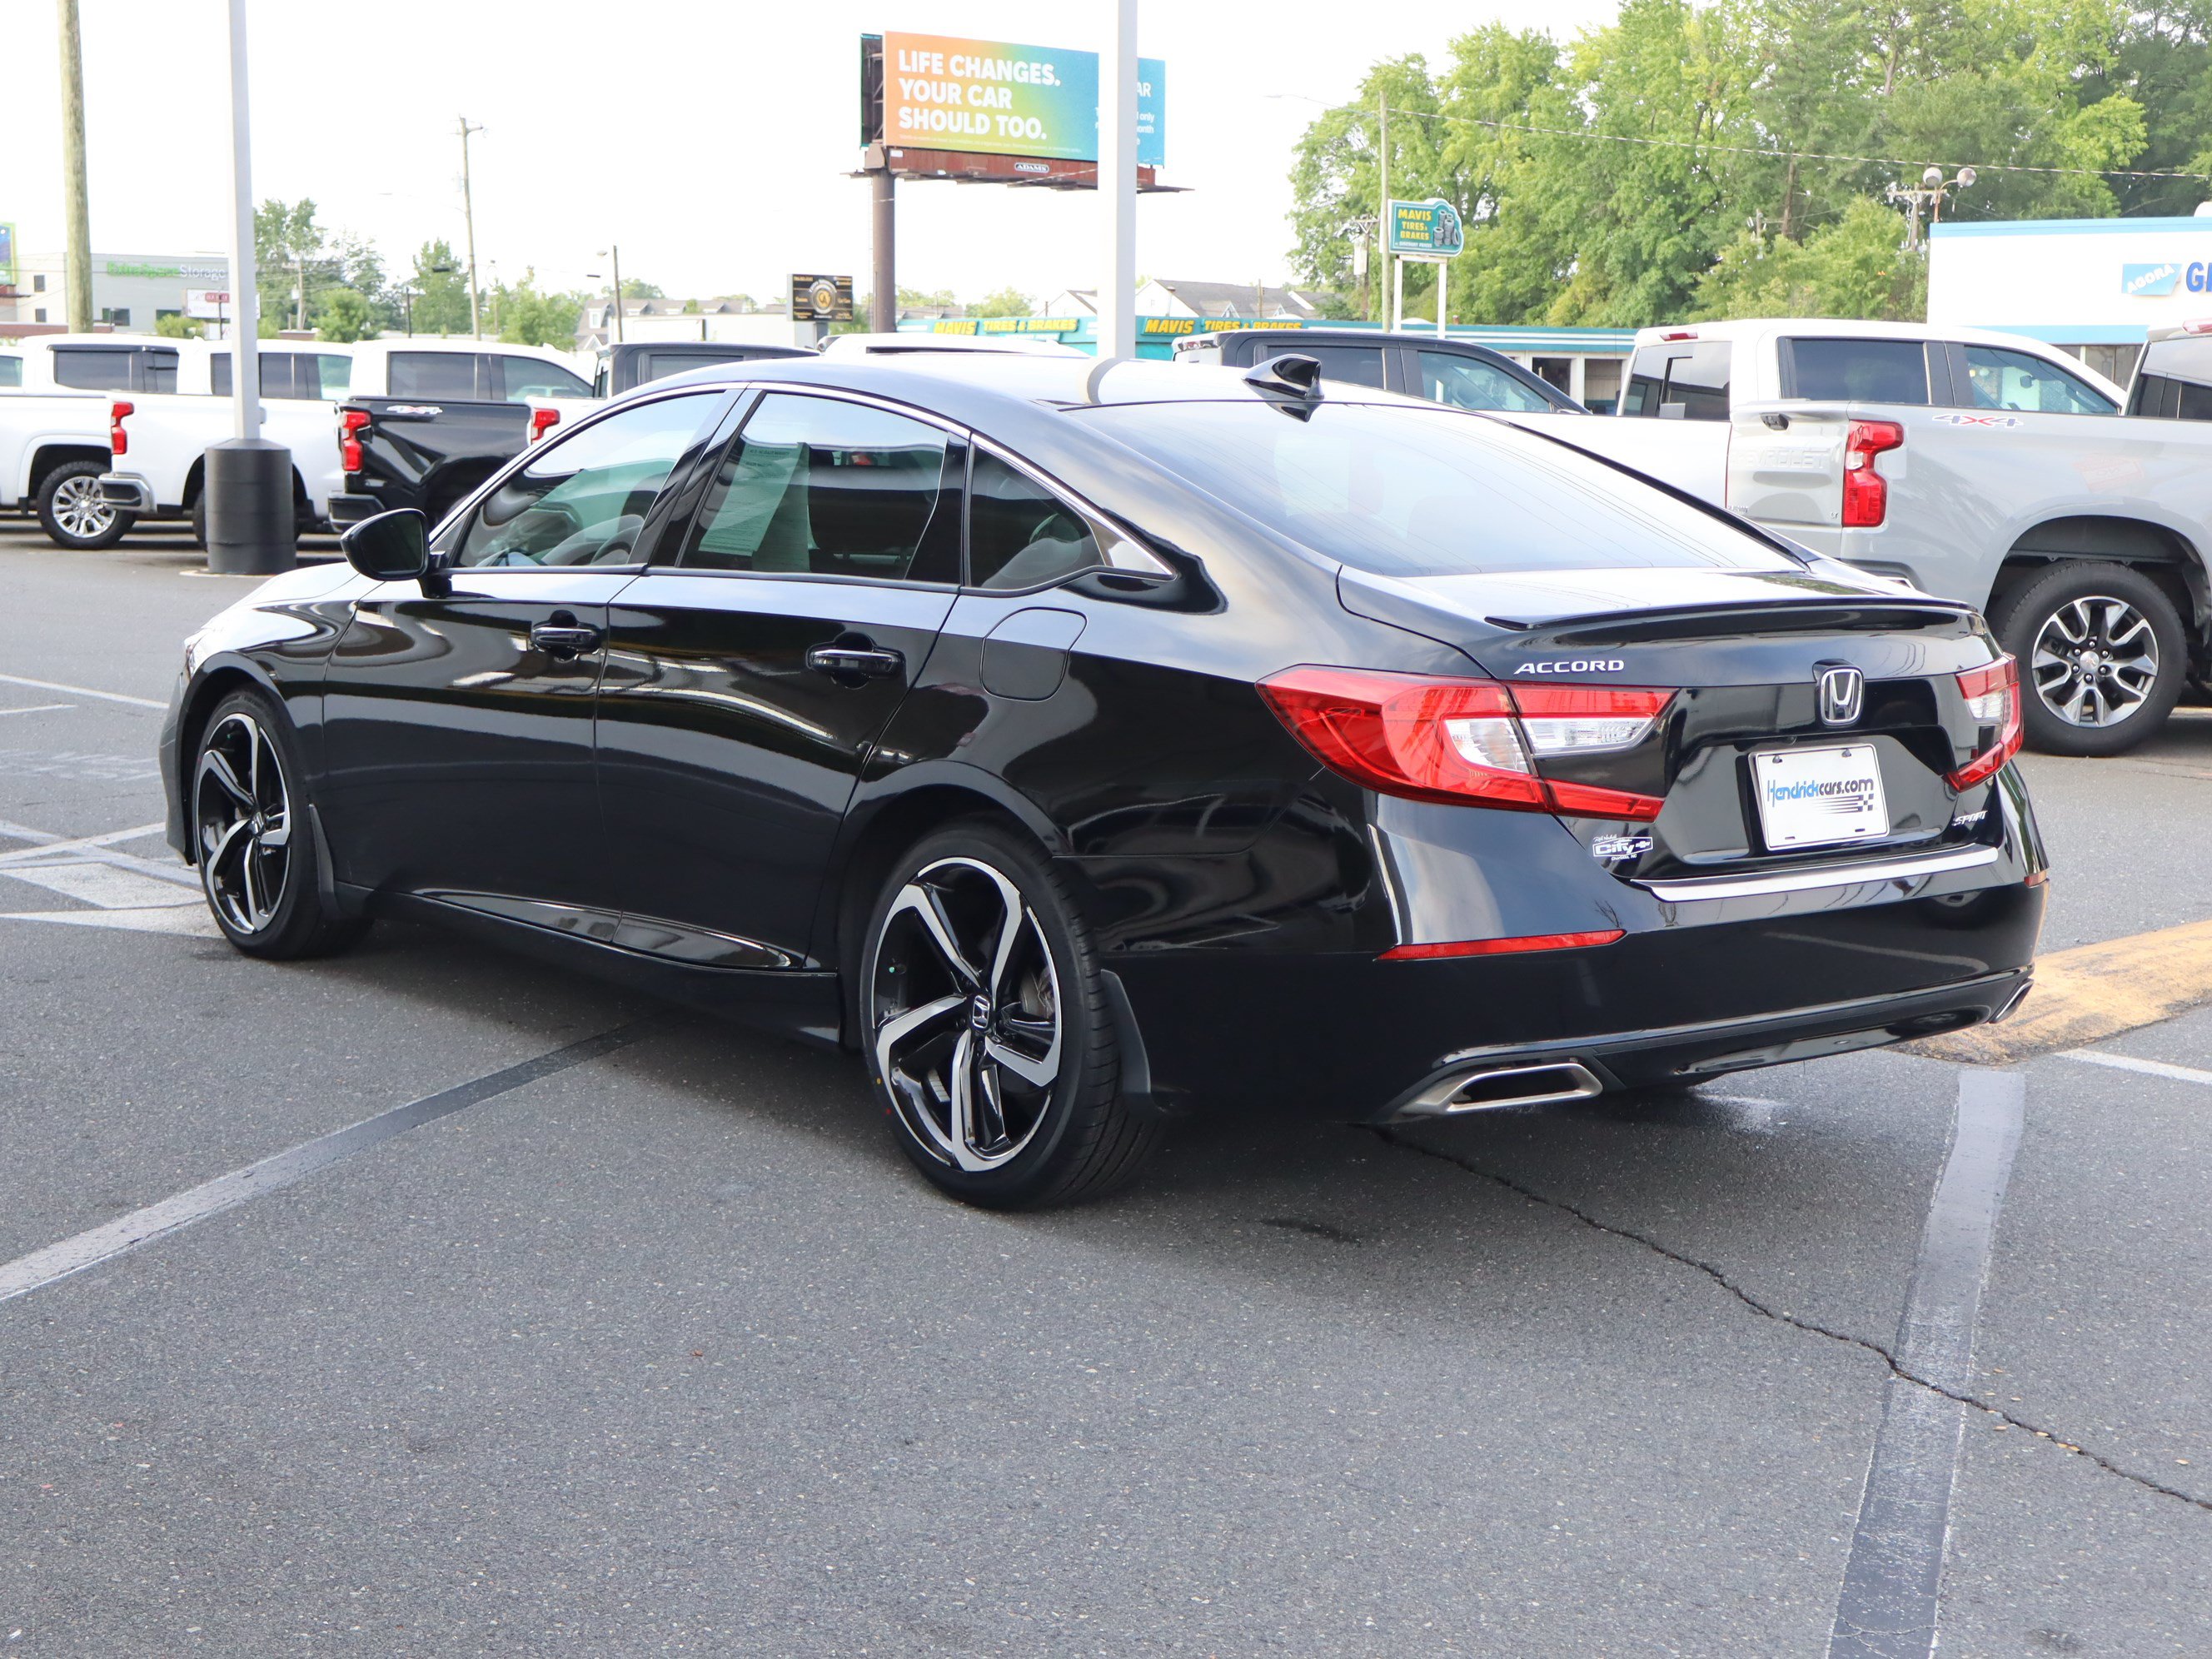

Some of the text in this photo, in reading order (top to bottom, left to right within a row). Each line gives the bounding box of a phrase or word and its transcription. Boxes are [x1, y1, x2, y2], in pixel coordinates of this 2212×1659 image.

[899, 49, 1061, 87] LIFE CHANGES.
[899, 77, 1012, 109] YOUR CAR
[899, 107, 1047, 140] SHOULD TOO.
[1398, 208, 1432, 221] MAVIS
[1402, 221, 1425, 231] TIRES
[1400, 231, 1430, 240] BRAKES
[2127, 264, 2176, 294] AGORA
[934, 321, 977, 335] MAVIS
[984, 319, 1018, 331] TIRES
[1027, 318, 1079, 332] BRAKES
[1145, 319, 1195, 333] MAVIS
[1204, 320, 1241, 331] TIRES
[1513, 660, 1625, 675] ACCORD
[1767, 778, 1874, 808] Hendrickcars.com
[1951, 810, 1988, 827] SPORT
[1595, 841, 1635, 854] City
